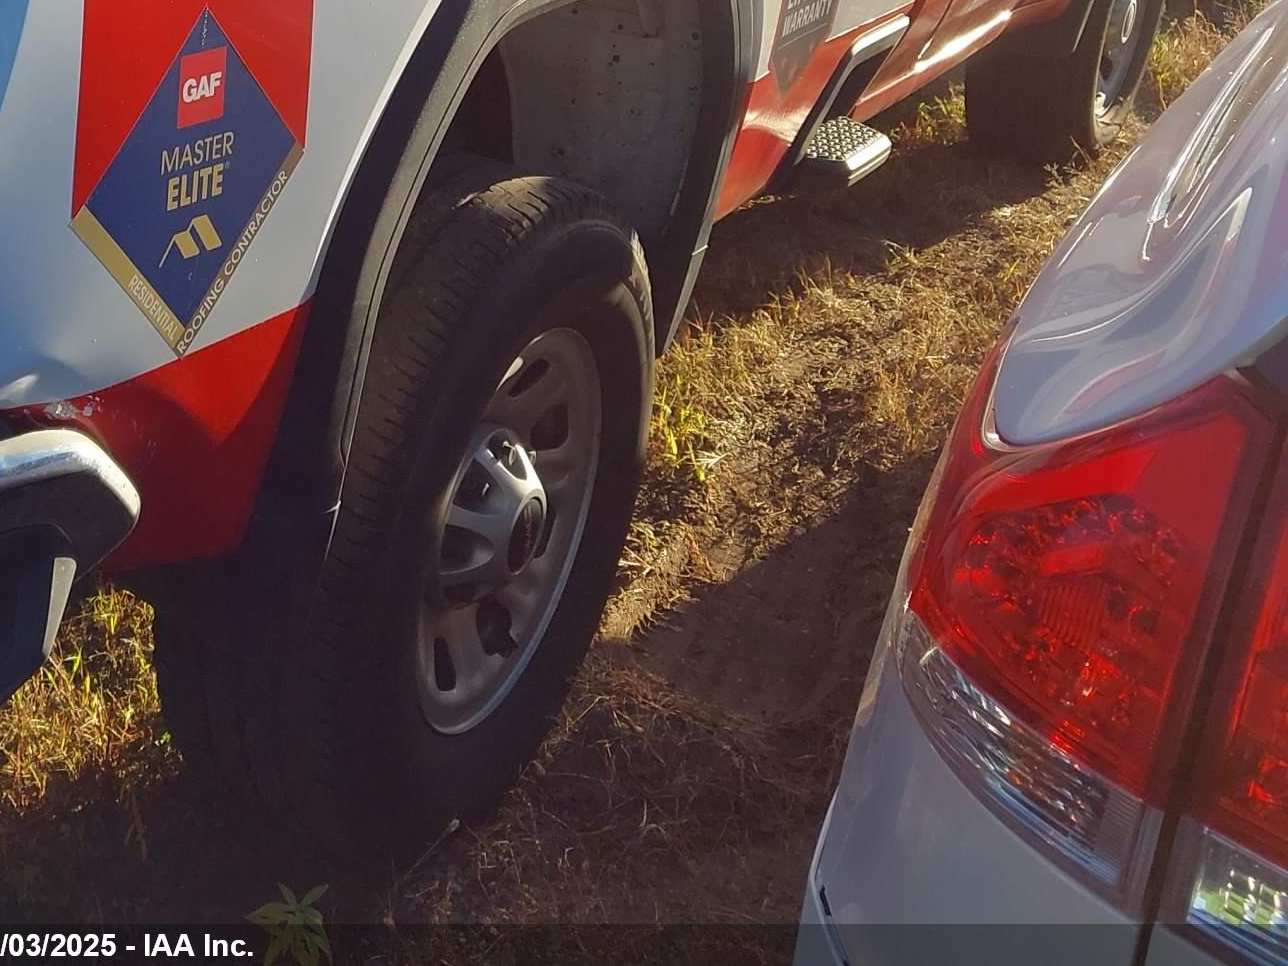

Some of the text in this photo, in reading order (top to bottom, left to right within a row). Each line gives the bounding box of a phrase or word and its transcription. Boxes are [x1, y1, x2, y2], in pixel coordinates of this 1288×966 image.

[182, 70, 223, 103] GAF
[160, 130, 235, 176] MASTER
[166, 161, 225, 212] ELITE
[175, 168, 290, 356] ROOFING CONTRACTOR
[127, 274, 177, 341] RESIDENTIAL
